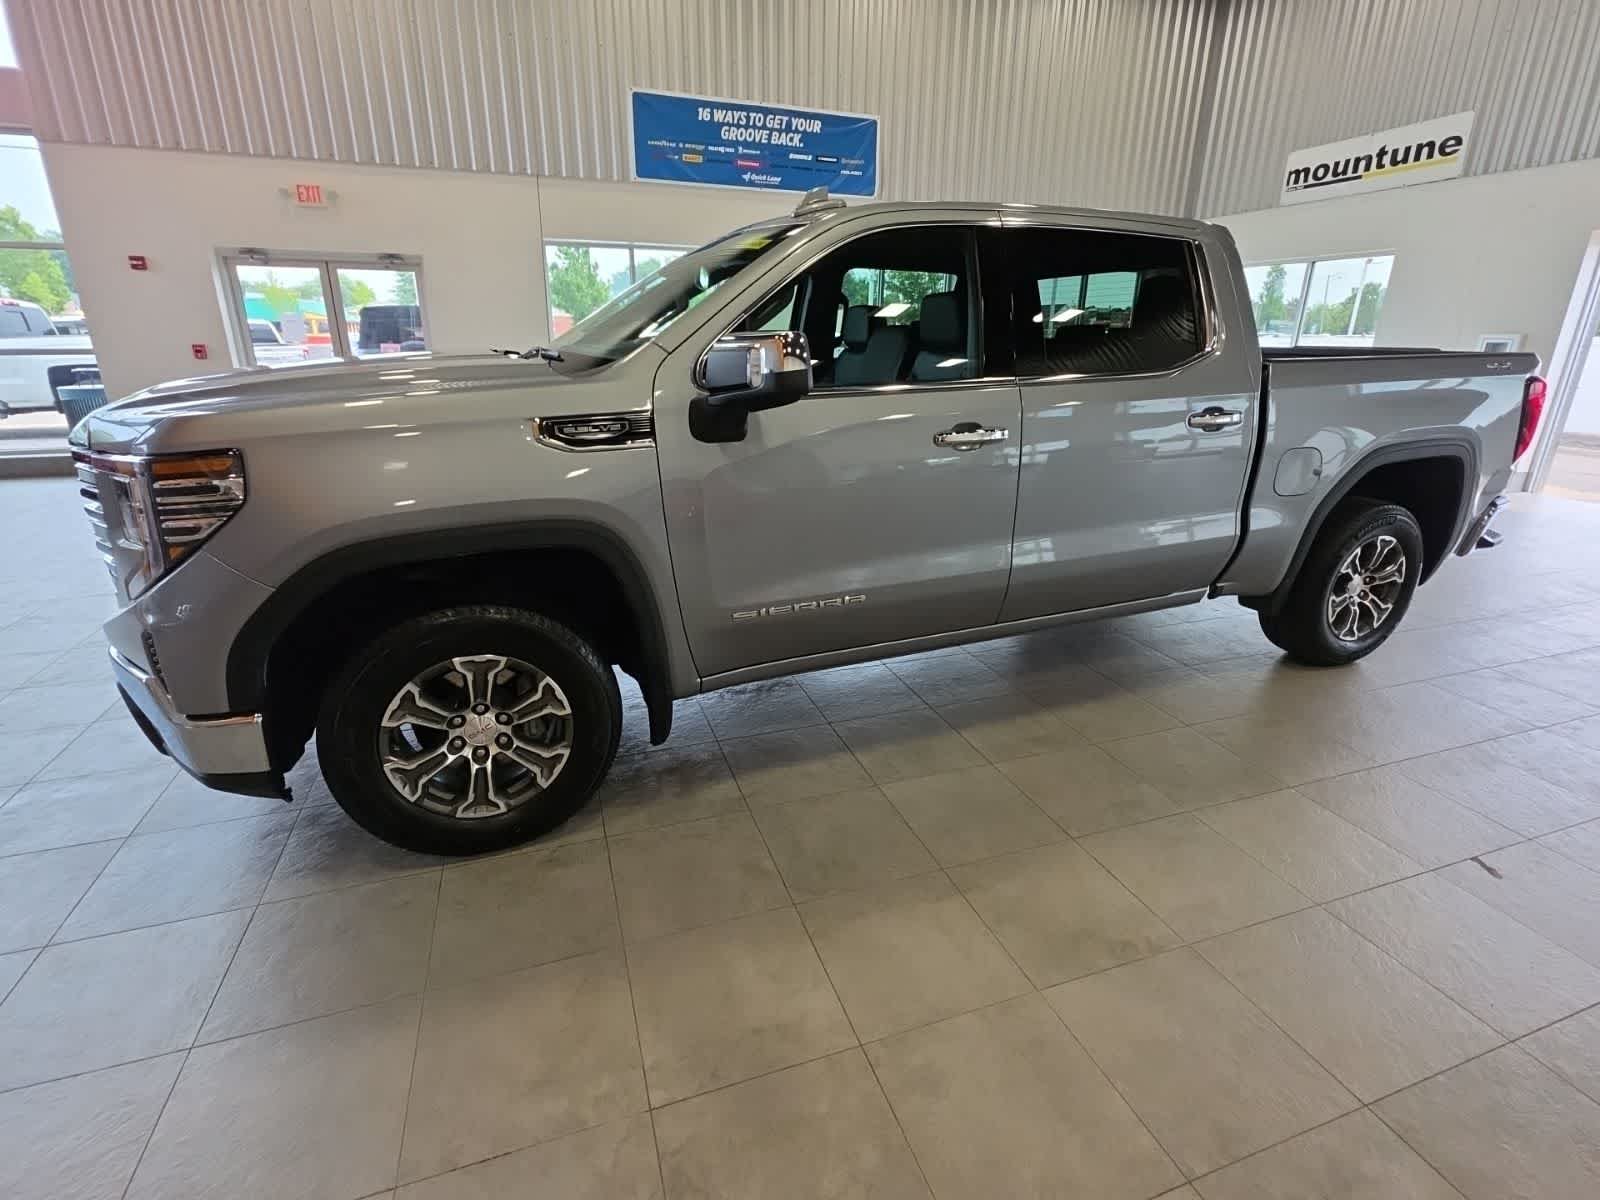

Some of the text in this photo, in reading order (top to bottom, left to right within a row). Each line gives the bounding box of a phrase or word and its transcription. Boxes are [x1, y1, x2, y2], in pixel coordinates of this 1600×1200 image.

[697, 107, 822, 133] 16 WAYS TO GET YOUR
[720, 126, 804, 148] GROOVE BACK.
[1285, 135, 1463, 187] mountune
[296, 184, 321, 204] EXIT
[731, 594, 867, 621] SIERRA
